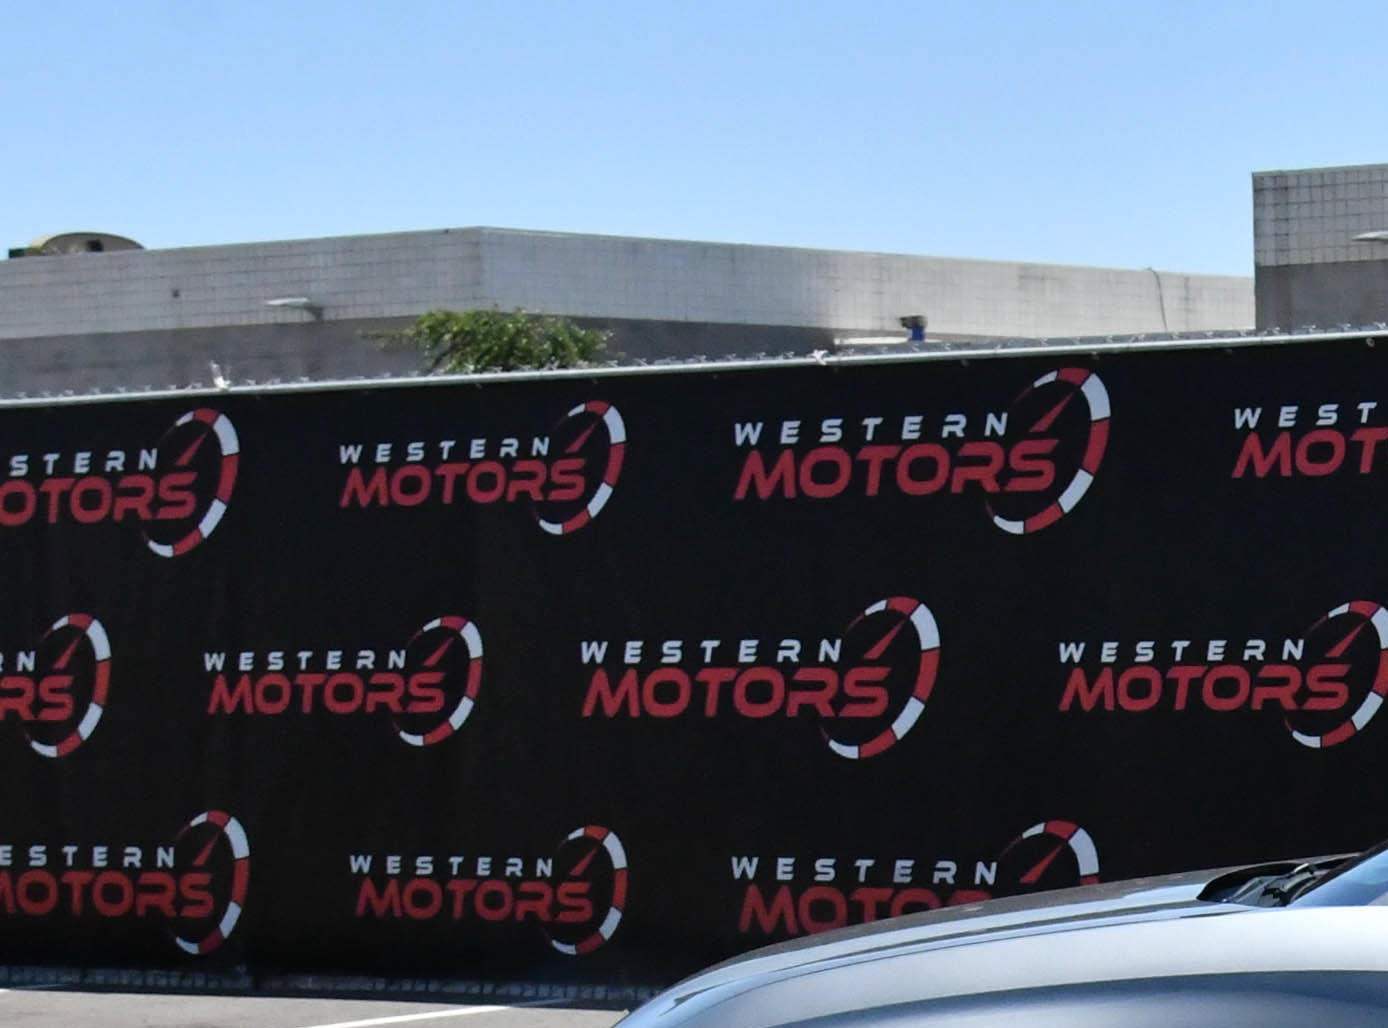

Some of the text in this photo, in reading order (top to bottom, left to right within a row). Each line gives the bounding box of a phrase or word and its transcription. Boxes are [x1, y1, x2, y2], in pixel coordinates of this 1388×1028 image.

[735, 413, 1007, 445] WESTERN
[11, 449, 157, 476] STERN
[341, 437, 549, 463] WESTERN
[341, 459, 584, 506] MOTORS
[736, 440, 1056, 499] MOTORS
[205, 650, 405, 671] WESTERN
[582, 639, 841, 663] WESTERN
[1060, 639, 1304, 663] WESTERN
[208, 672, 444, 714] MOTORS
[583, 667, 888, 717] MOTORS
[1060, 664, 1348, 711] MOTORS
[0, 846, 173, 867] ESTERN
[351, 856, 552, 876] WESTERN
[732, 857, 996, 884] WESTERN
[358, 878, 592, 922] MOTORS
